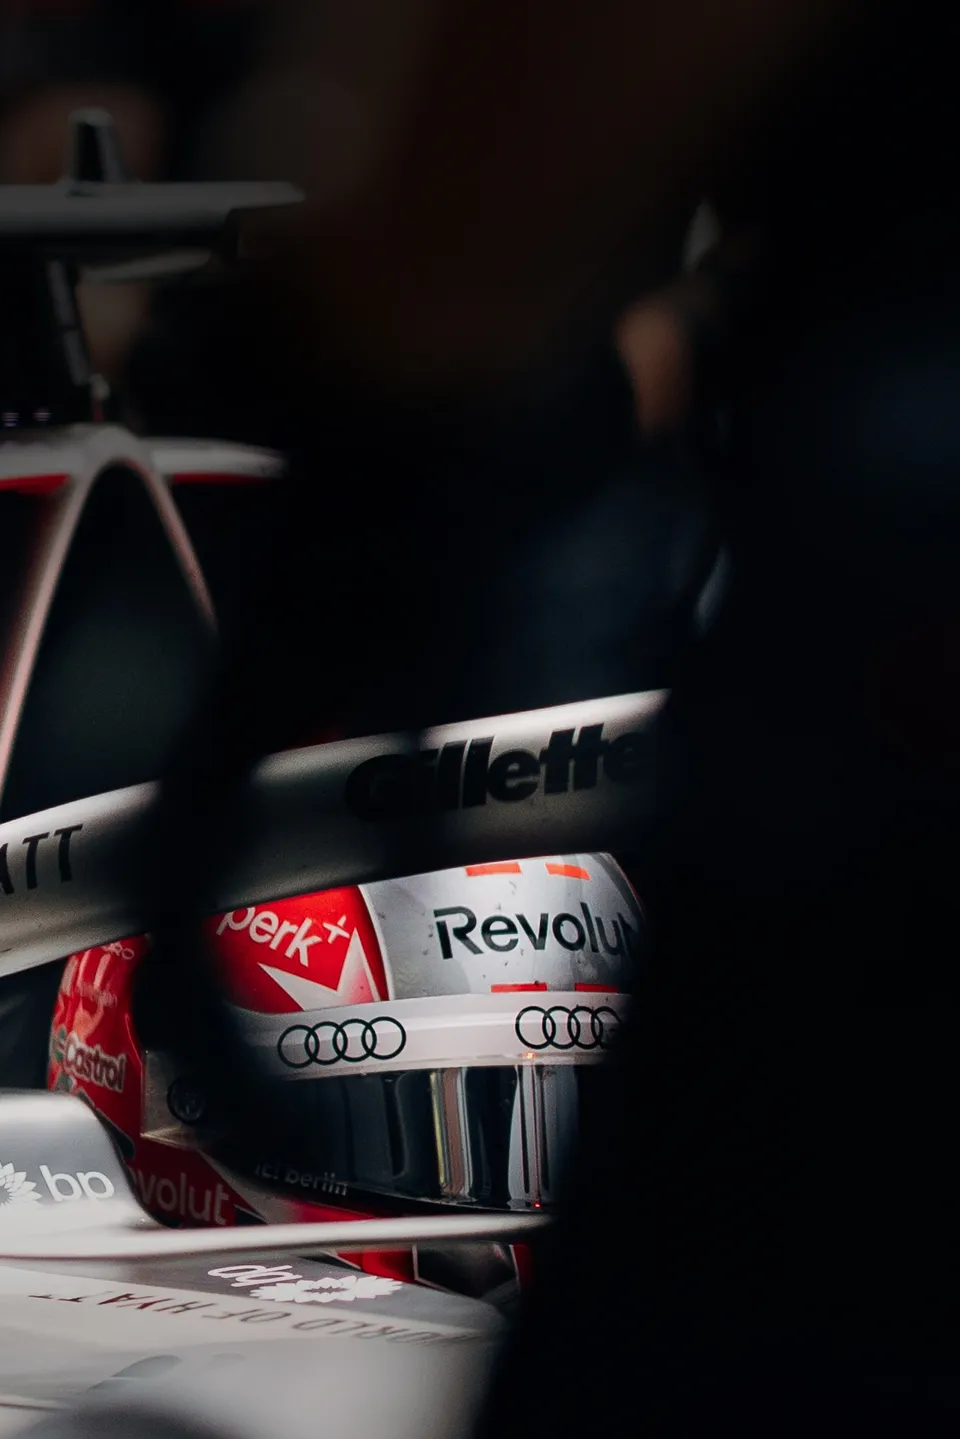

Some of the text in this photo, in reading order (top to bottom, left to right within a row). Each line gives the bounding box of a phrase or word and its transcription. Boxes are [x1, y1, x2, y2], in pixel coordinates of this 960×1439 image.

[65, 1033, 128, 1093] Castrol
[39, 1164, 115, 1203] bp
[133, 1167, 231, 1226] volut
